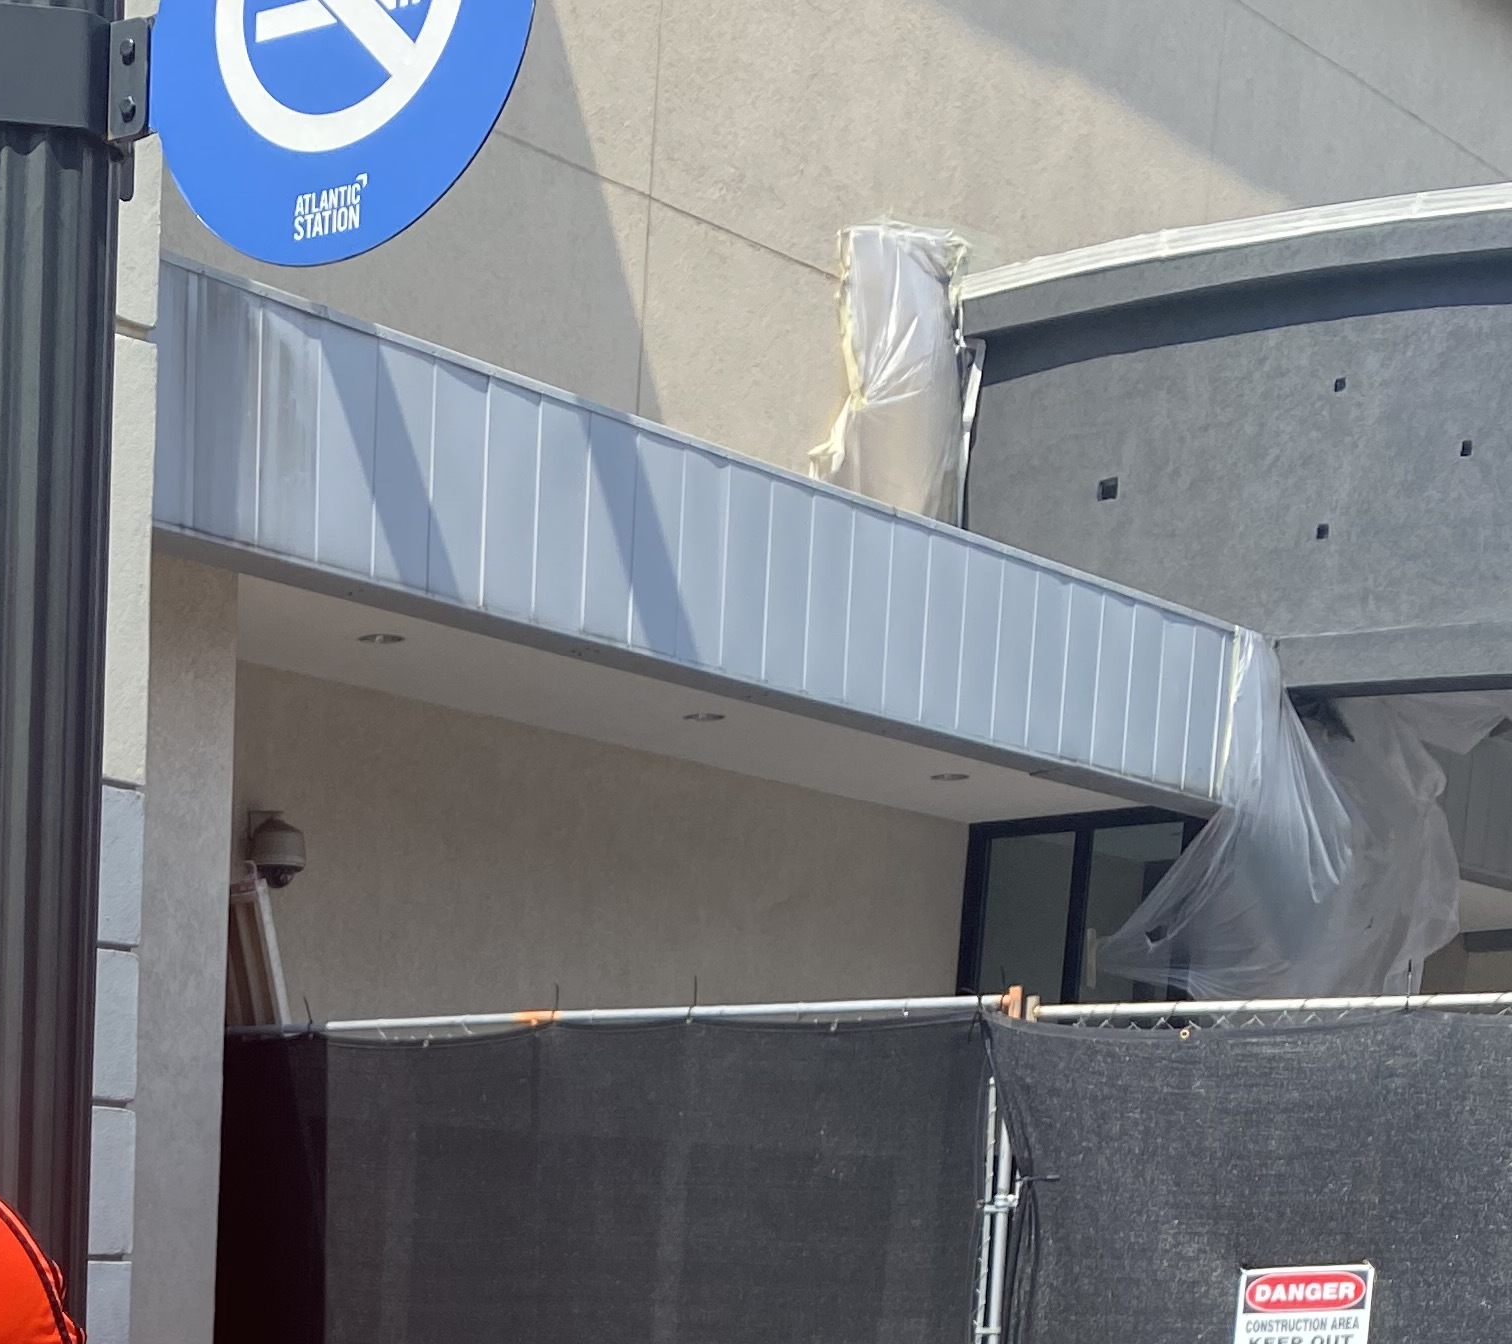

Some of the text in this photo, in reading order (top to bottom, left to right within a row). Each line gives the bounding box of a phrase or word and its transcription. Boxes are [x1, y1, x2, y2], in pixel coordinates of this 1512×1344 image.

[294, 182, 361, 217] ATLANTIC
[293, 203, 360, 241] STATION
[1254, 1282, 1357, 1302] DANGER
[1245, 1316, 1360, 1334] CONSTRUCTION AREA
